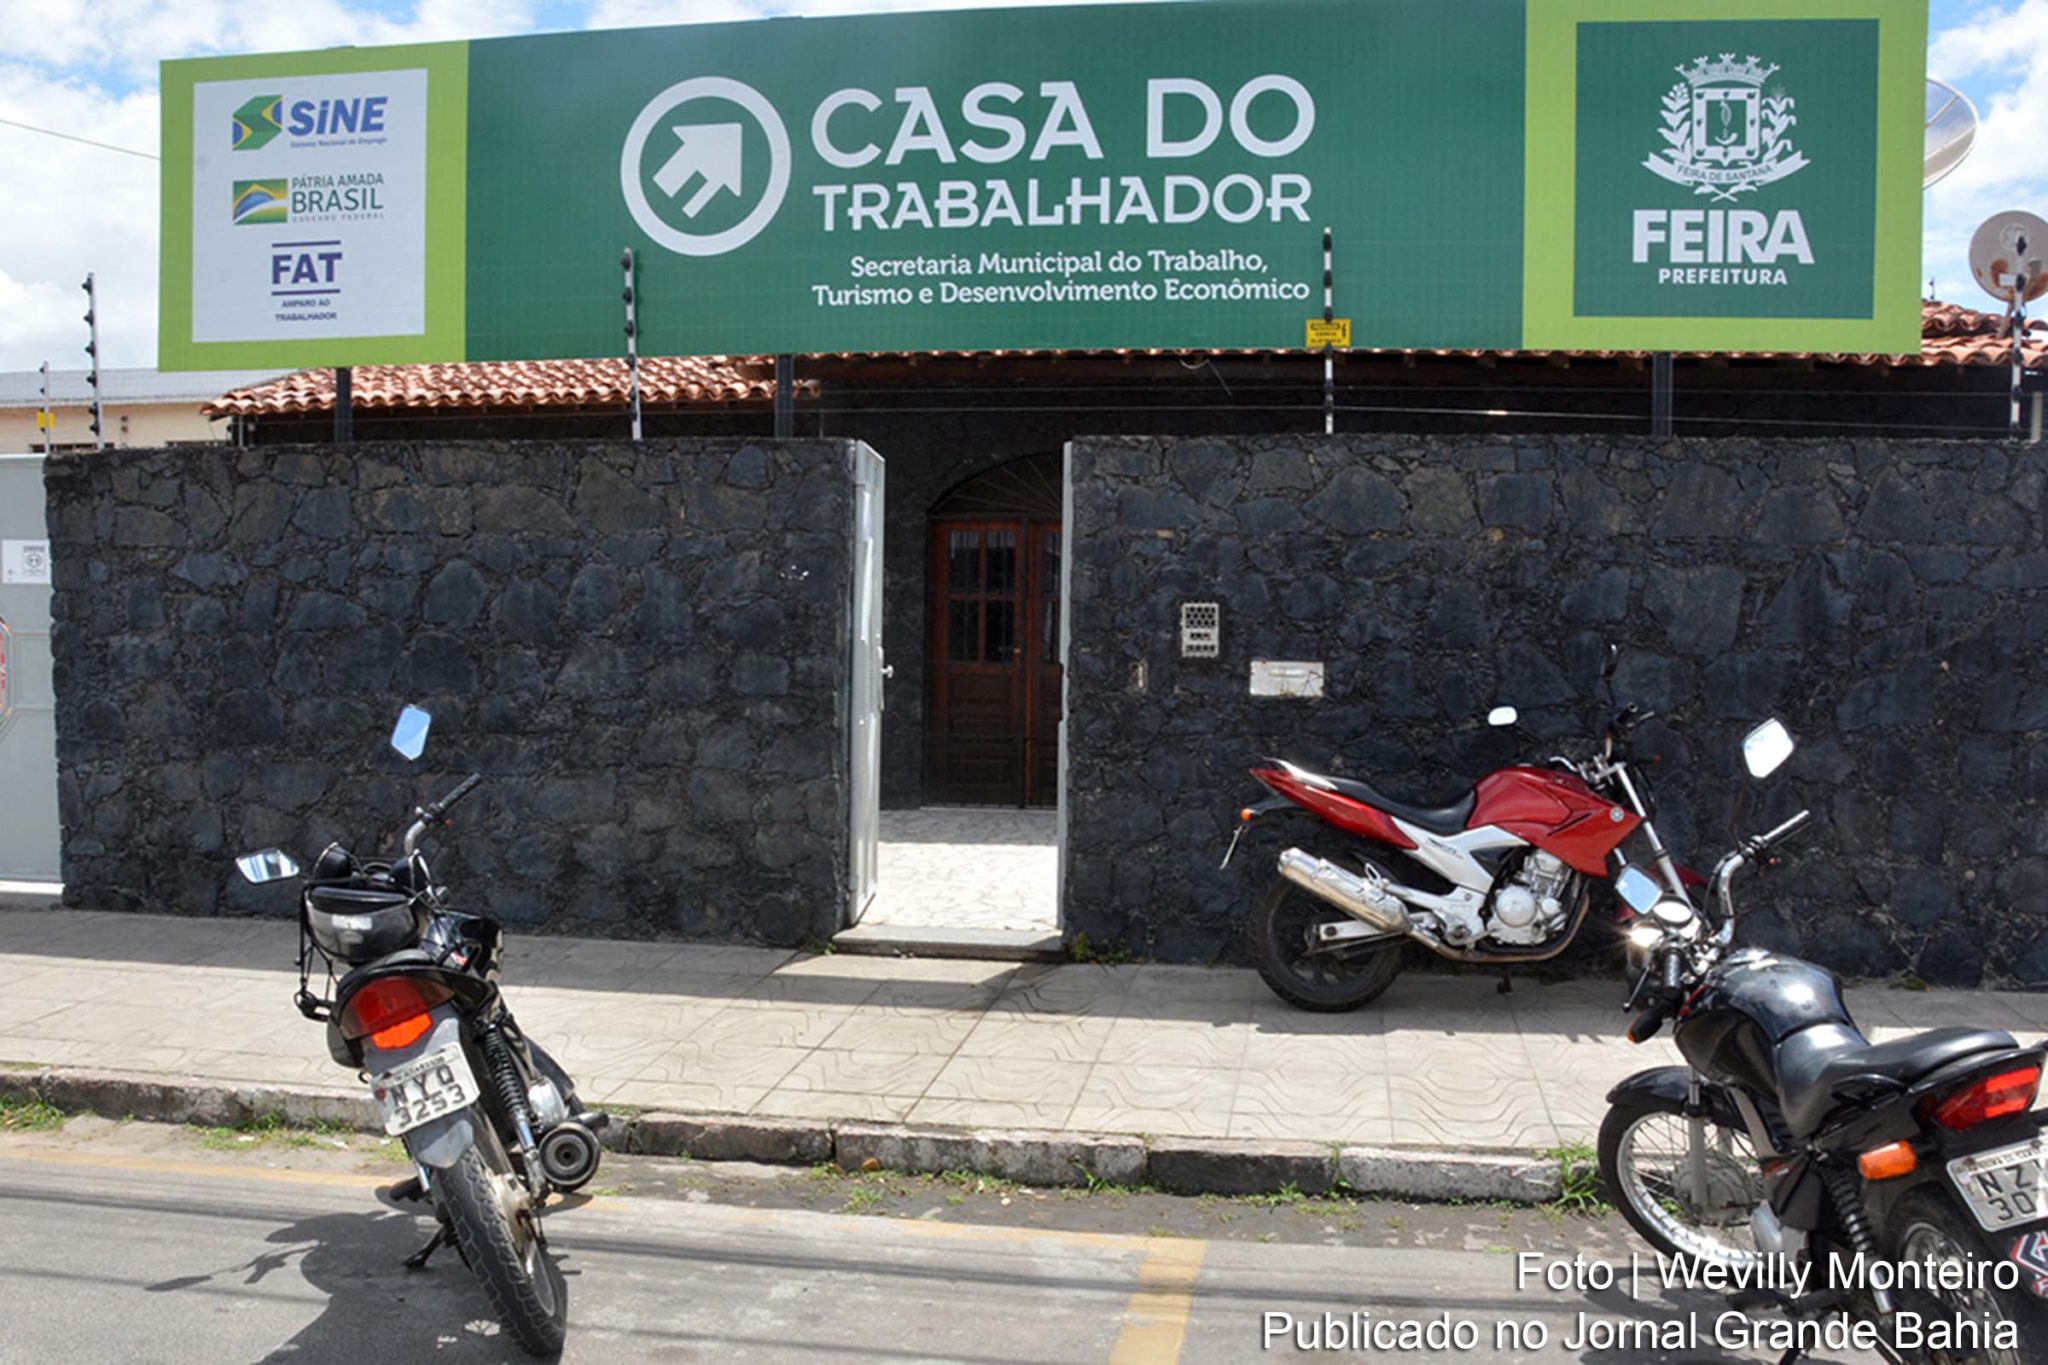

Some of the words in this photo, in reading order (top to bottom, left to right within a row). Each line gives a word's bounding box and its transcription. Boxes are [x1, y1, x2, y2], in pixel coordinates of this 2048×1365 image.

[811, 81, 1104, 168] CASA
[1147, 74, 1315, 158] DO
[292, 173, 335, 189] PÁTRIA
[337, 173, 384, 188] AMADA
[1677, 165, 1706, 181] FEIRA
[1709, 171, 1723, 181] DE
[1726, 164, 1774, 181] SANTANA
[292, 187, 384, 214] BRASIL
[812, 174, 1312, 231] TRABALHADOR
[292, 214, 337, 223] GOVERNO
[341, 212, 384, 221] FEDERAL
[1632, 209, 1815, 264] FEIRA
[272, 252, 343, 285] FAT
[851, 253, 972, 278] Secretaria
[978, 251, 1102, 278] Municipal
[1108, 250, 1142, 273] do
[1147, 249, 1268, 274] Trabalho,
[1658, 268, 1788, 285] PREFEITURA
[282, 299, 316, 308] AMPARO
[318, 298, 330, 306] AO
[812, 284, 913, 306] Turismo
[919, 287, 933, 304] e
[940, 280, 1157, 304] Desenvolvimento
[1164, 277, 1310, 300] Econômico
[275, 312, 337, 321] TRABALHADOR
[394, 1083, 466, 1128] 3253
